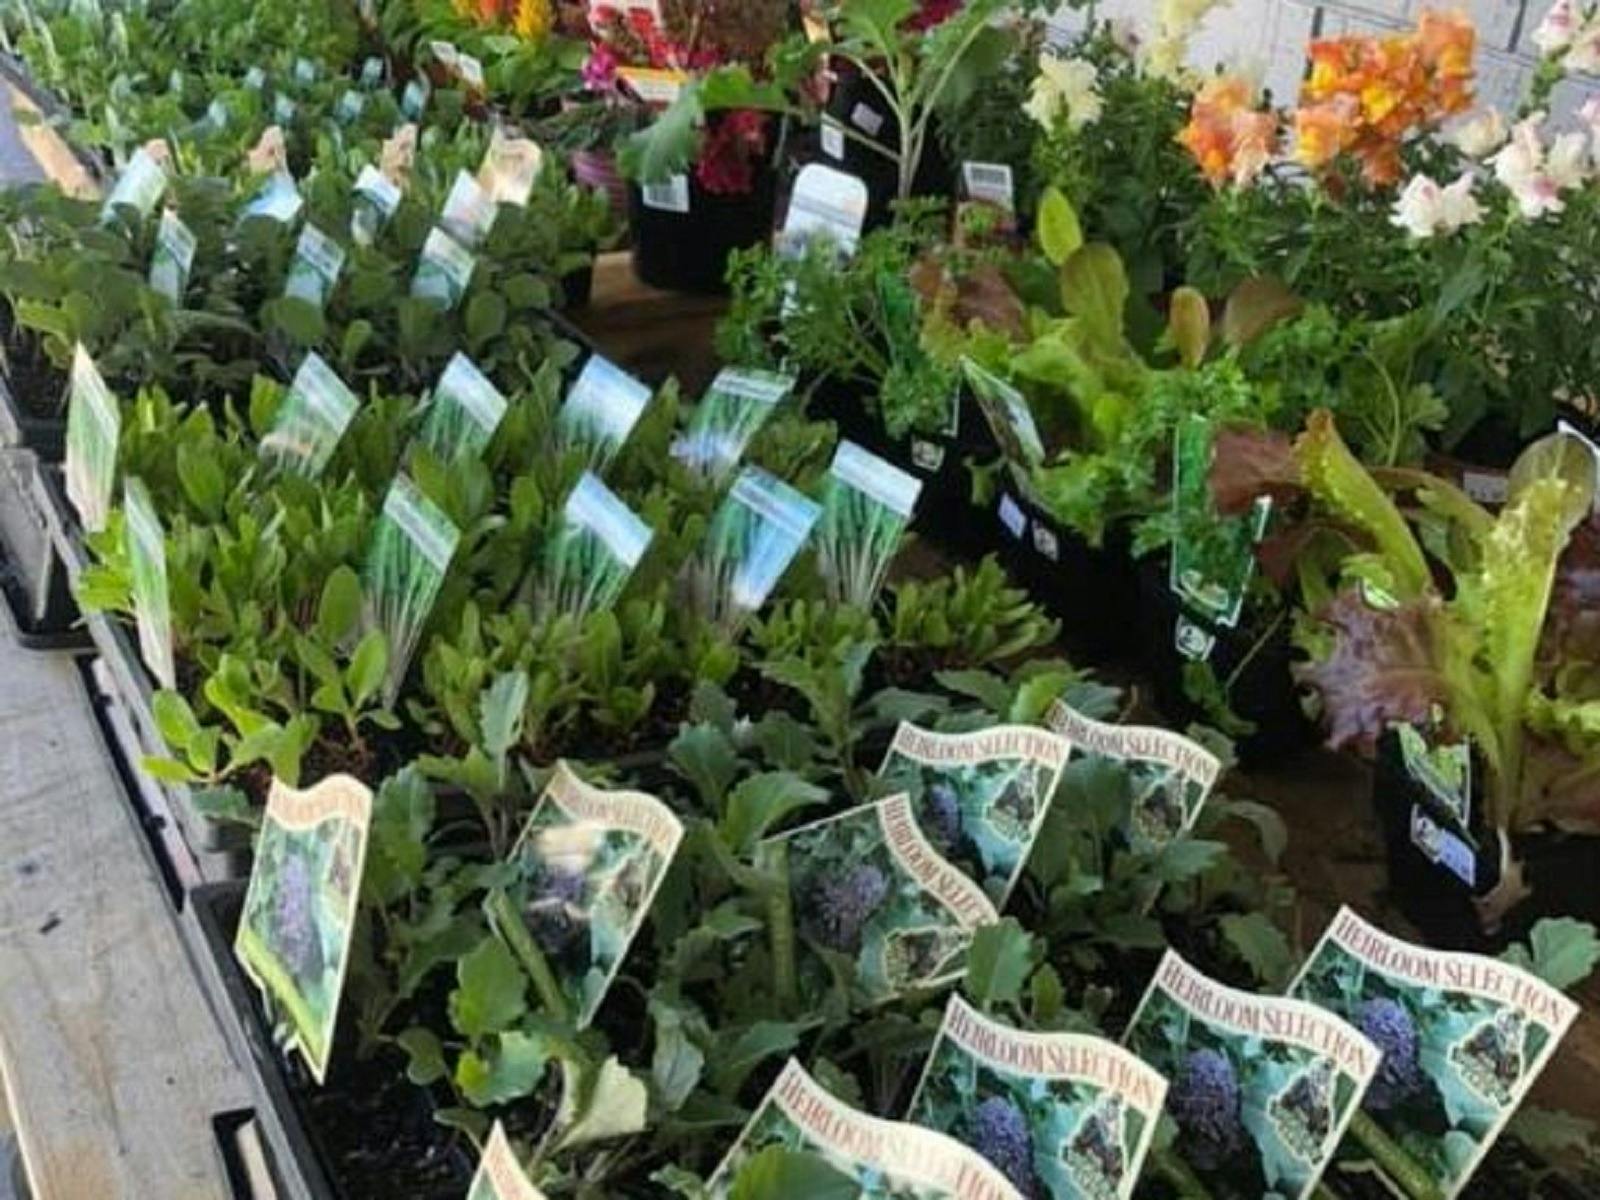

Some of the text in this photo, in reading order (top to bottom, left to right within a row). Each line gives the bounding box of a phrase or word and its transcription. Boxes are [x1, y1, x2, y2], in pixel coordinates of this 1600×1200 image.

[1162, 960, 1370, 1076] HEIRLOOM SELECTION
[1335, 914, 1567, 1025] HEIRLOOM SELECTION
[947, 1001, 1155, 1107] HEIRLOOM SELECTION
[778, 1068, 885, 1163] HEIRLOOM
